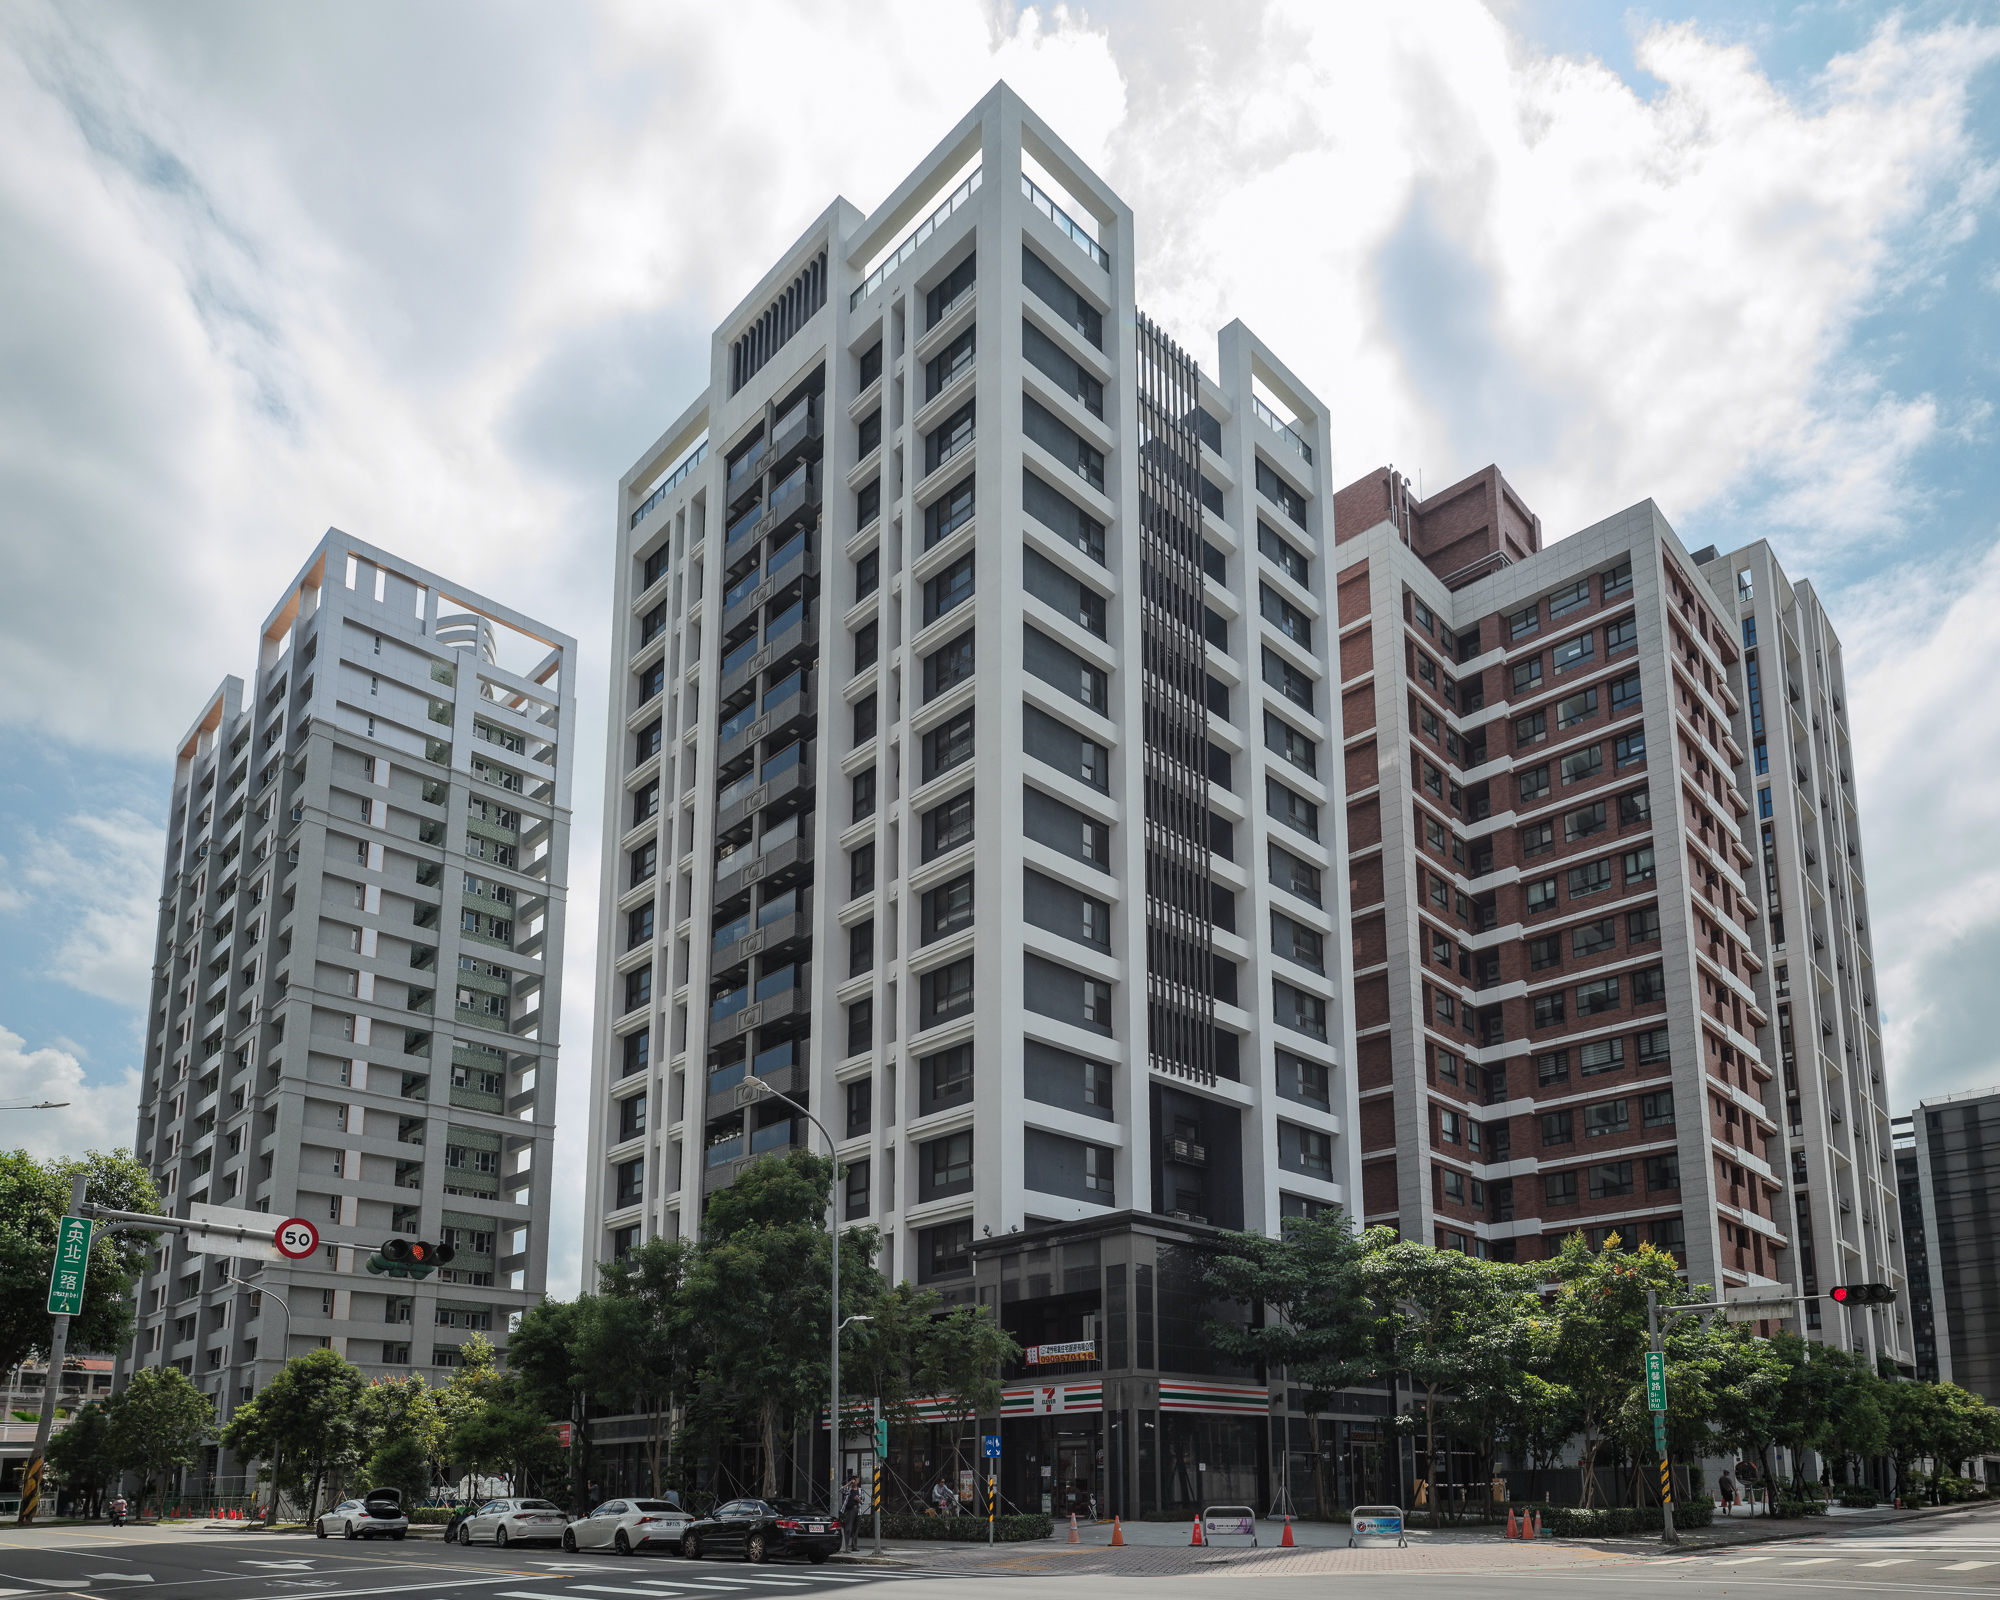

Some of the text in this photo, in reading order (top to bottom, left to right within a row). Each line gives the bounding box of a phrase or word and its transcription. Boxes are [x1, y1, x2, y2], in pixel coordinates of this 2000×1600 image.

[284, 1231, 310, 1247] 50
[59, 1229, 84, 1291] 央北二路
[1026, 1347, 1039, 1364] 租
[1040, 1352, 1094, 1364] 0909570118
